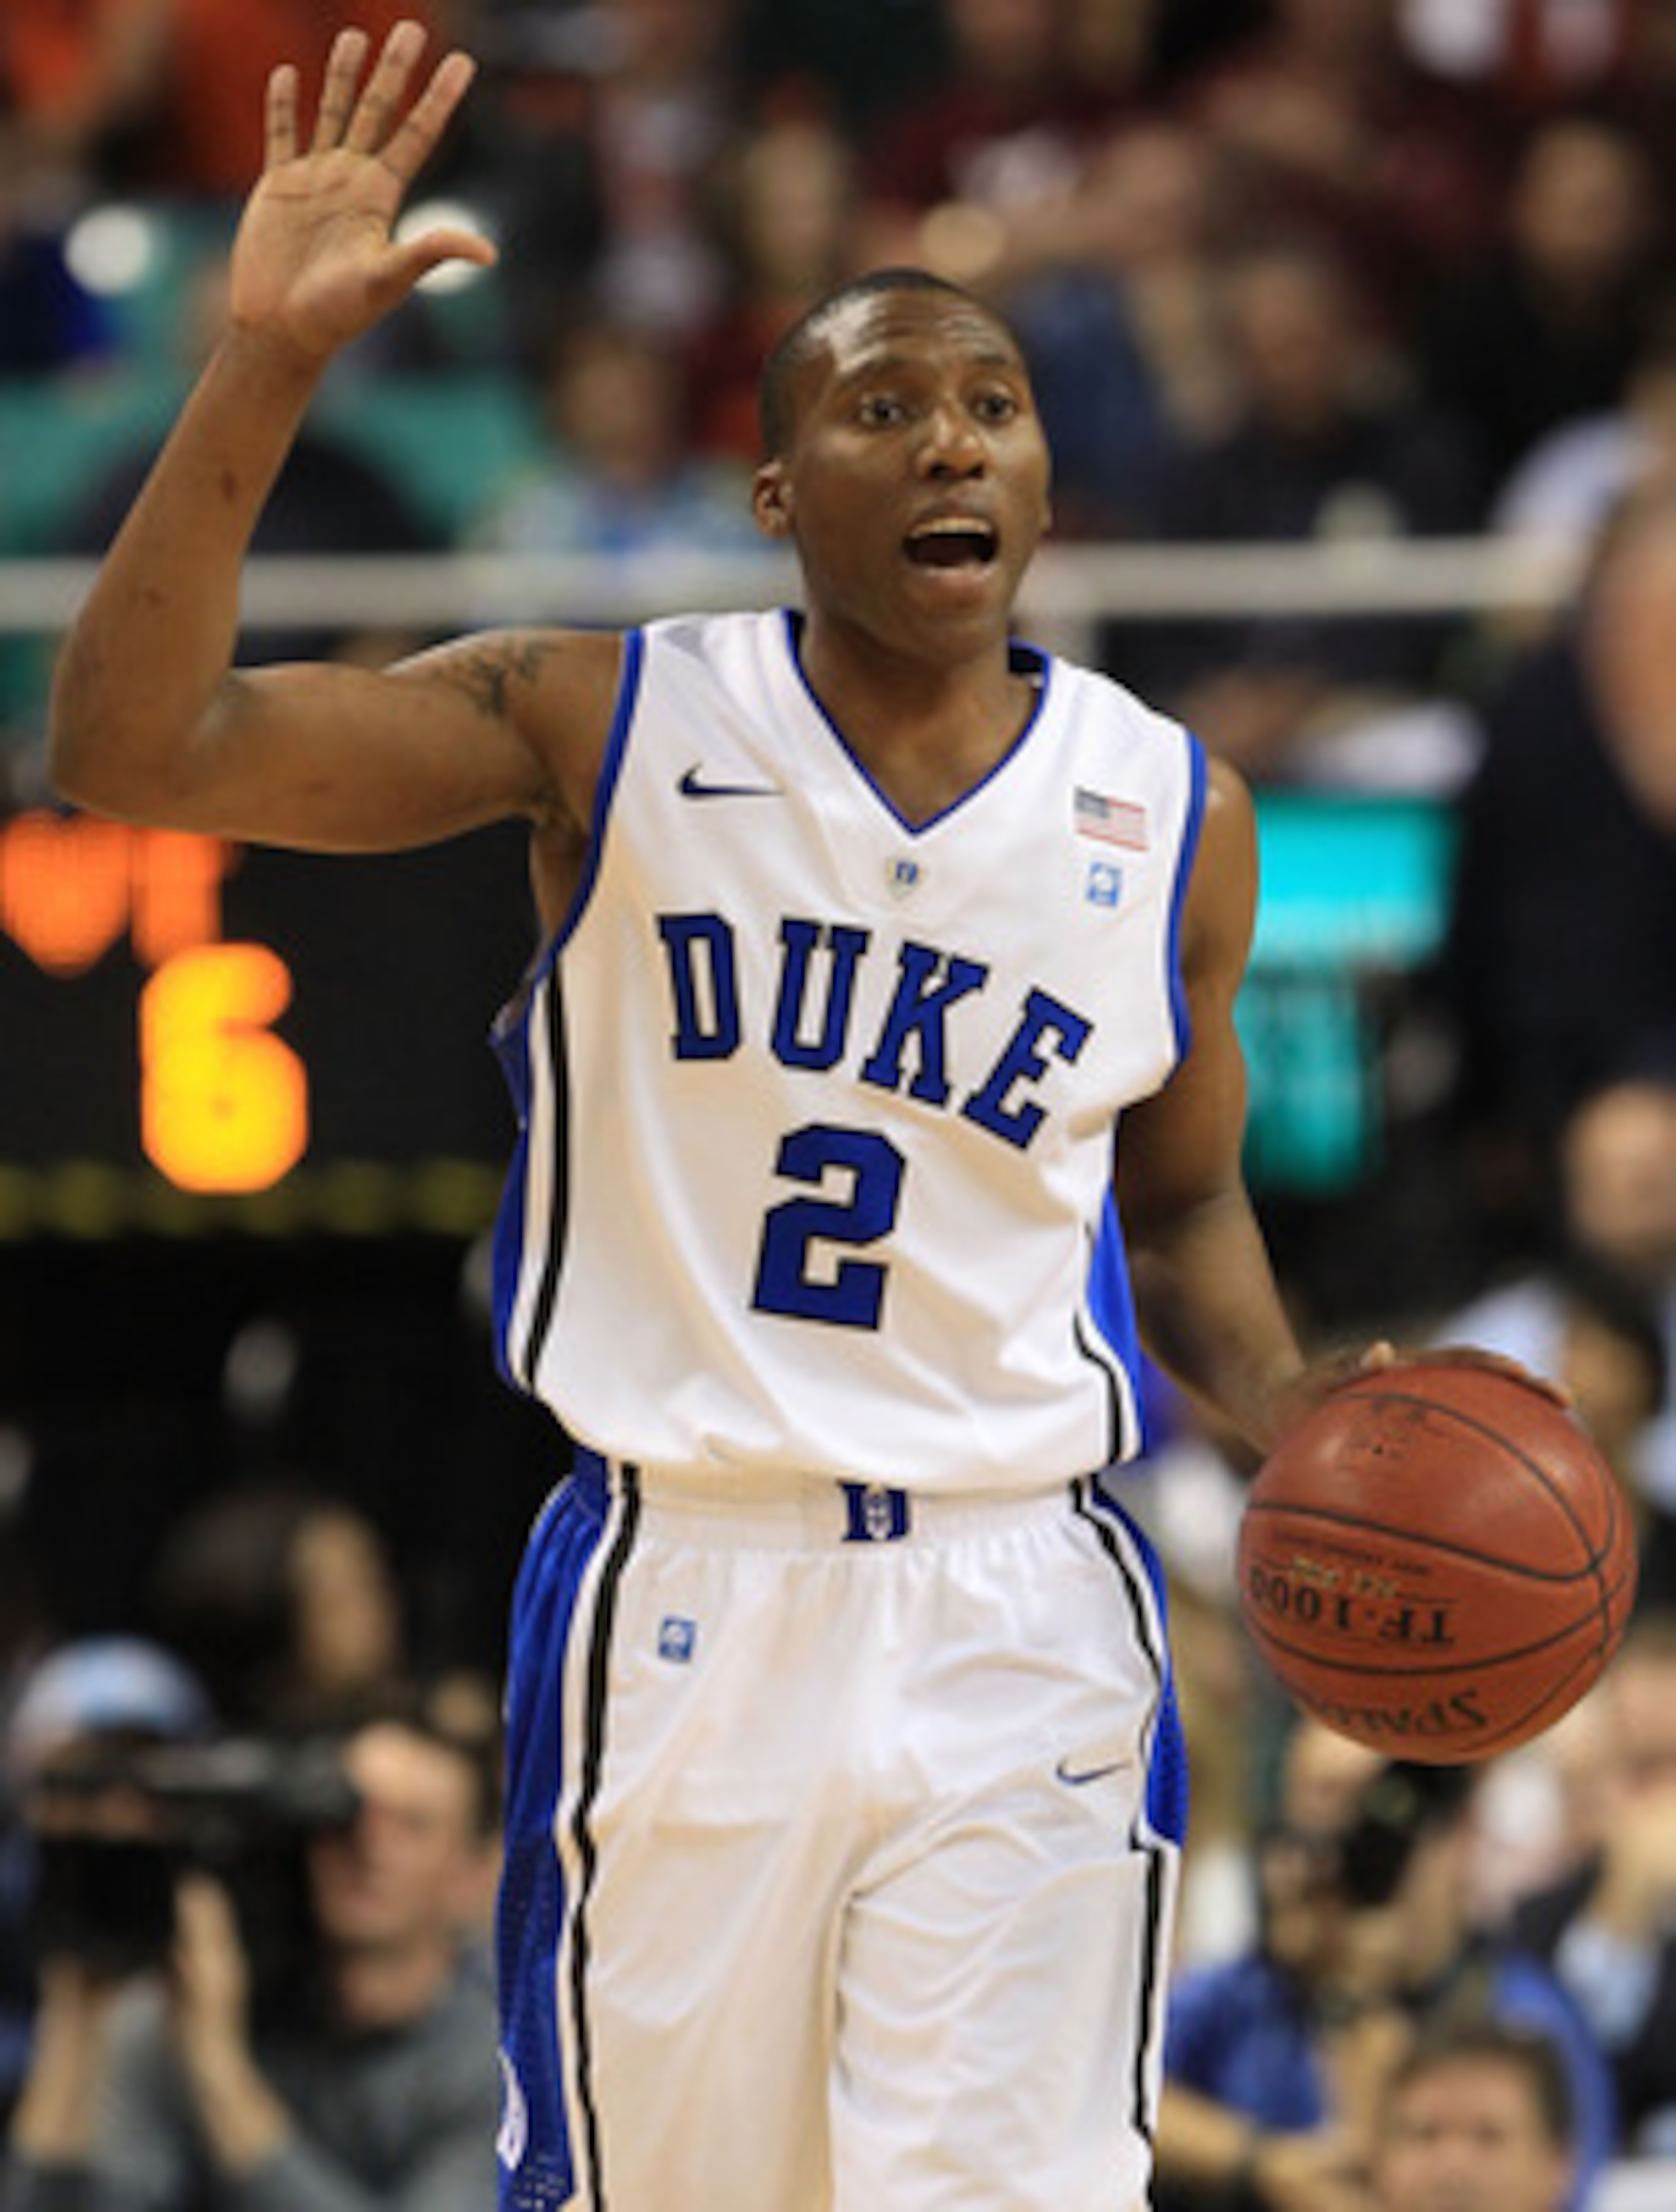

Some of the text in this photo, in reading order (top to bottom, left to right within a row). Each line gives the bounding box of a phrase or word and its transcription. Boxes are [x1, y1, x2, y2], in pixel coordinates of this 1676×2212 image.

[140, 943, 309, 1193] 6
[656, 914, 1094, 1150] DUKE
[749, 1124, 906, 1331] 2
